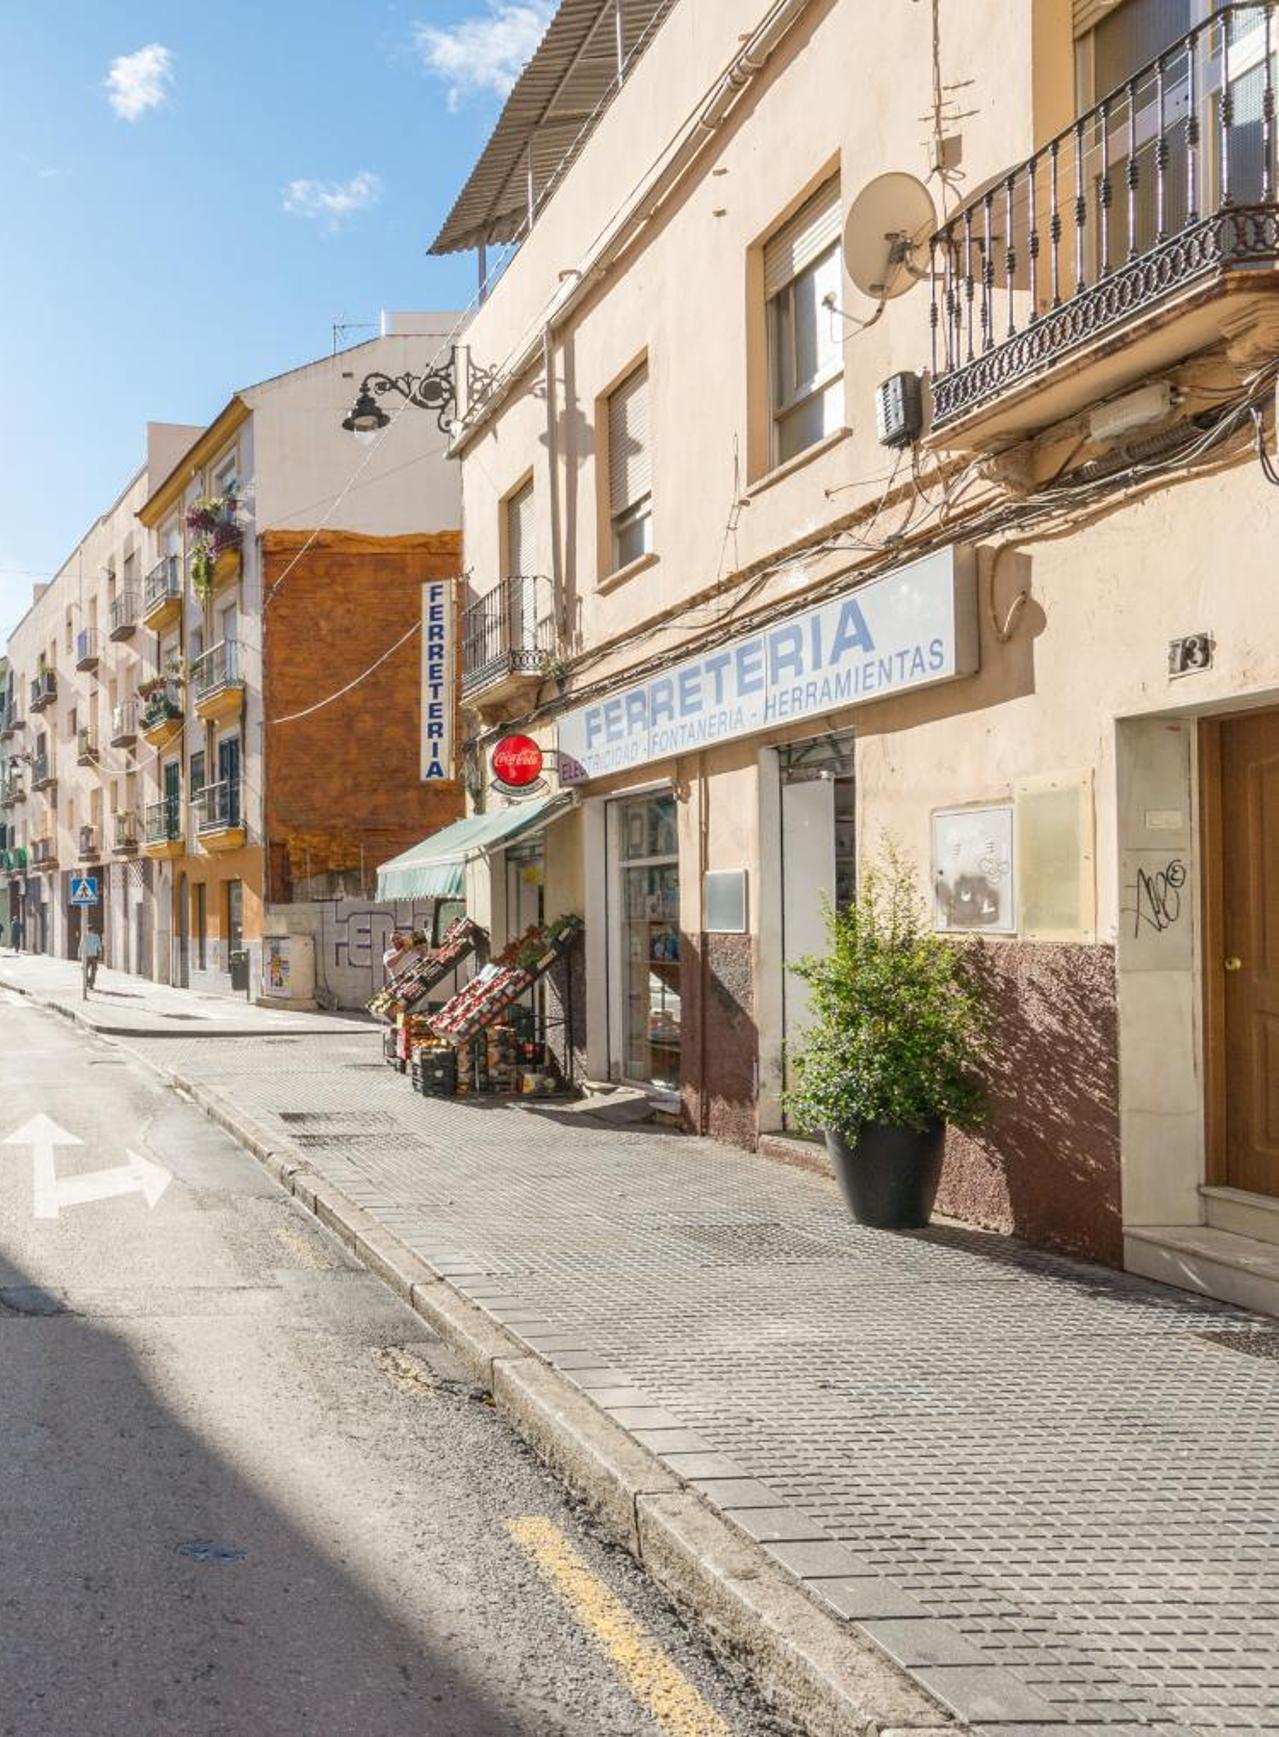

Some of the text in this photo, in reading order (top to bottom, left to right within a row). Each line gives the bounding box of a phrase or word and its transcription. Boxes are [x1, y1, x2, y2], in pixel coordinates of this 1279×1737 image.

[426, 584, 444, 778] FERRETERIA
[585, 599, 875, 749] FERRETERIA
[651, 705, 744, 752] FONTANERIA
[765, 638, 945, 719] HERRAMIENTAS
